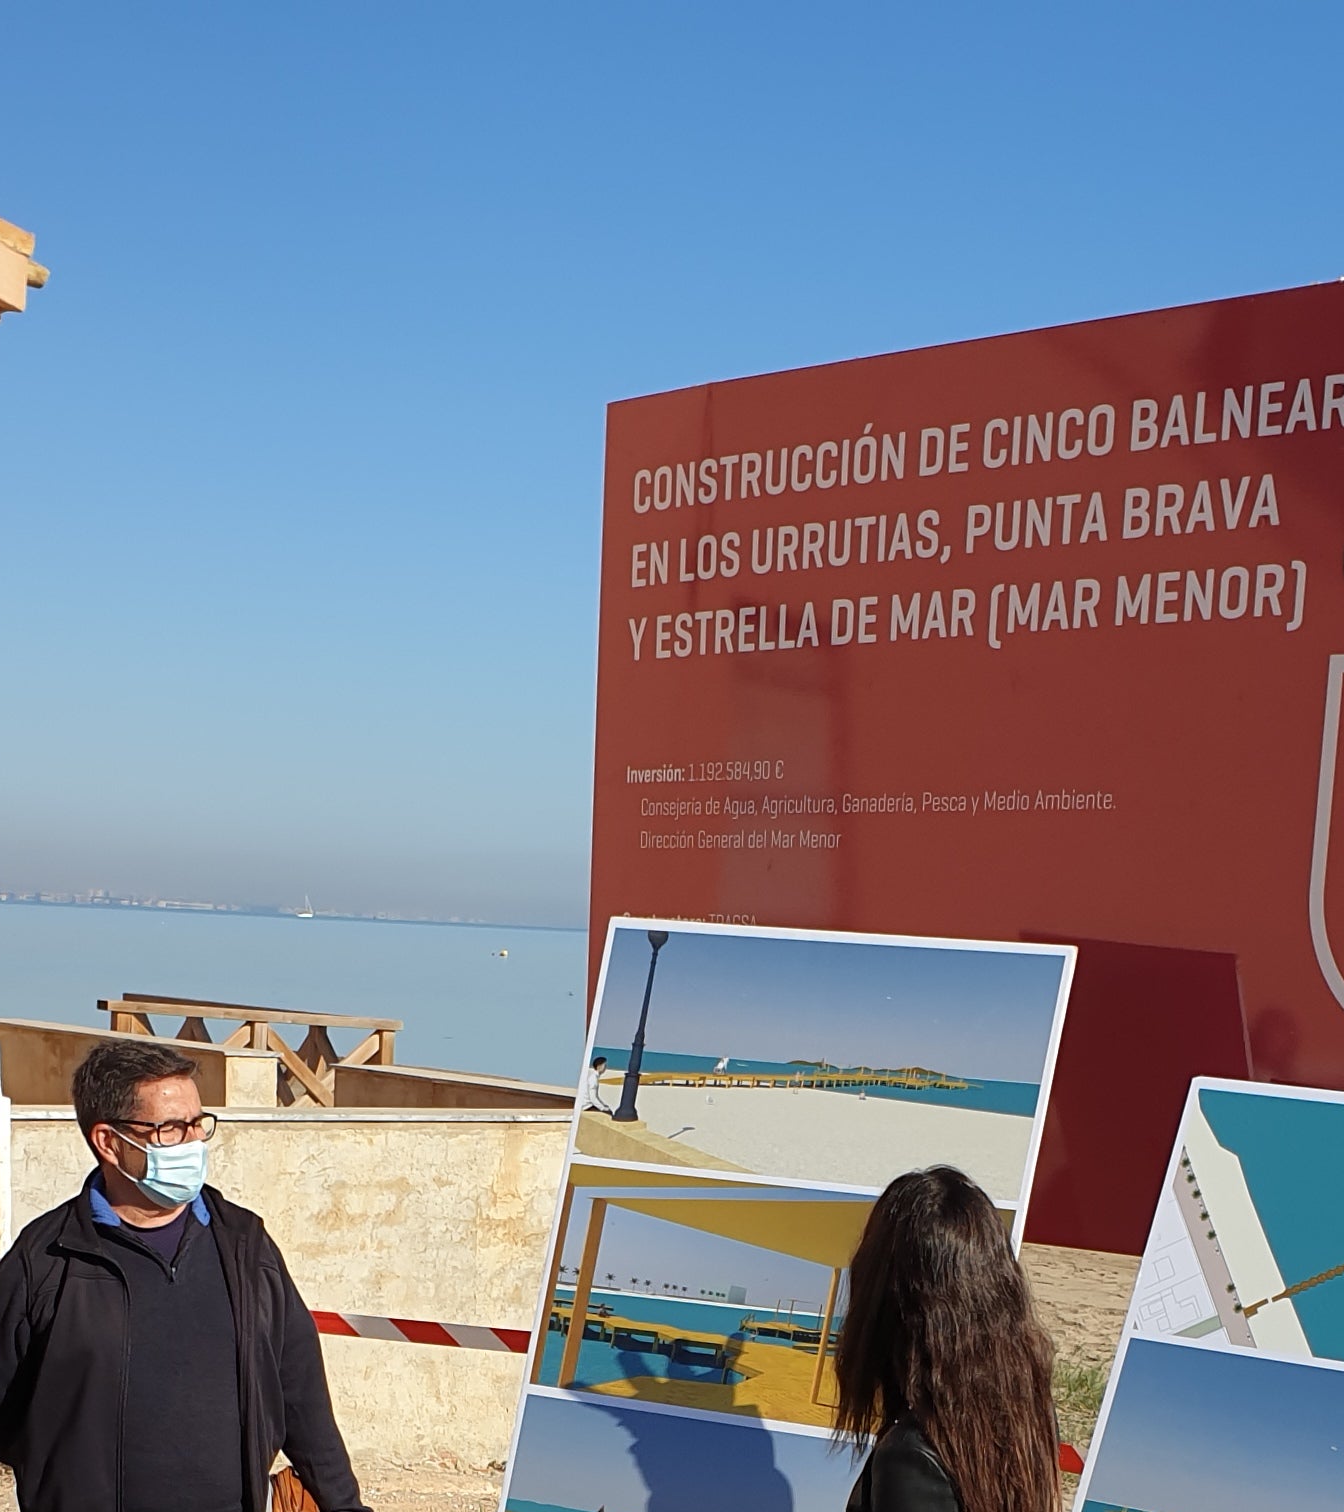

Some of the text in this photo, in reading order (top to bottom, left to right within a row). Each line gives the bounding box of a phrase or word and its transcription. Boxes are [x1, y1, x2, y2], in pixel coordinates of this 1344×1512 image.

[633, 423, 906, 514] CONSTRUCCIÓN
[919, 423, 970, 476] DE
[982, 404, 1115, 468] CINCO
[631, 474, 1280, 588] EN LOS URRUTIAS, PUNTA BRAVA
[628, 617, 647, 661] Y
[656, 602, 819, 659] ESTRELLA
[831, 596, 878, 646] DE
[890, 589, 975, 642] MAR
[627, 760, 784, 783] Inversión: 1.192.584,90 €
[706, 797, 720, 815] de
[724, 797, 757, 819] Agua,
[762, 796, 837, 819] Agricultura,
[842, 793, 917, 814] Ganadería,
[922, 792, 966, 812] Pesca
[972, 796, 979, 816] y
[984, 790, 1029, 811] Medio
[1034, 789, 1116, 810] Ambiente.
[640, 830, 841, 848] Dirección General del Mar Menor
